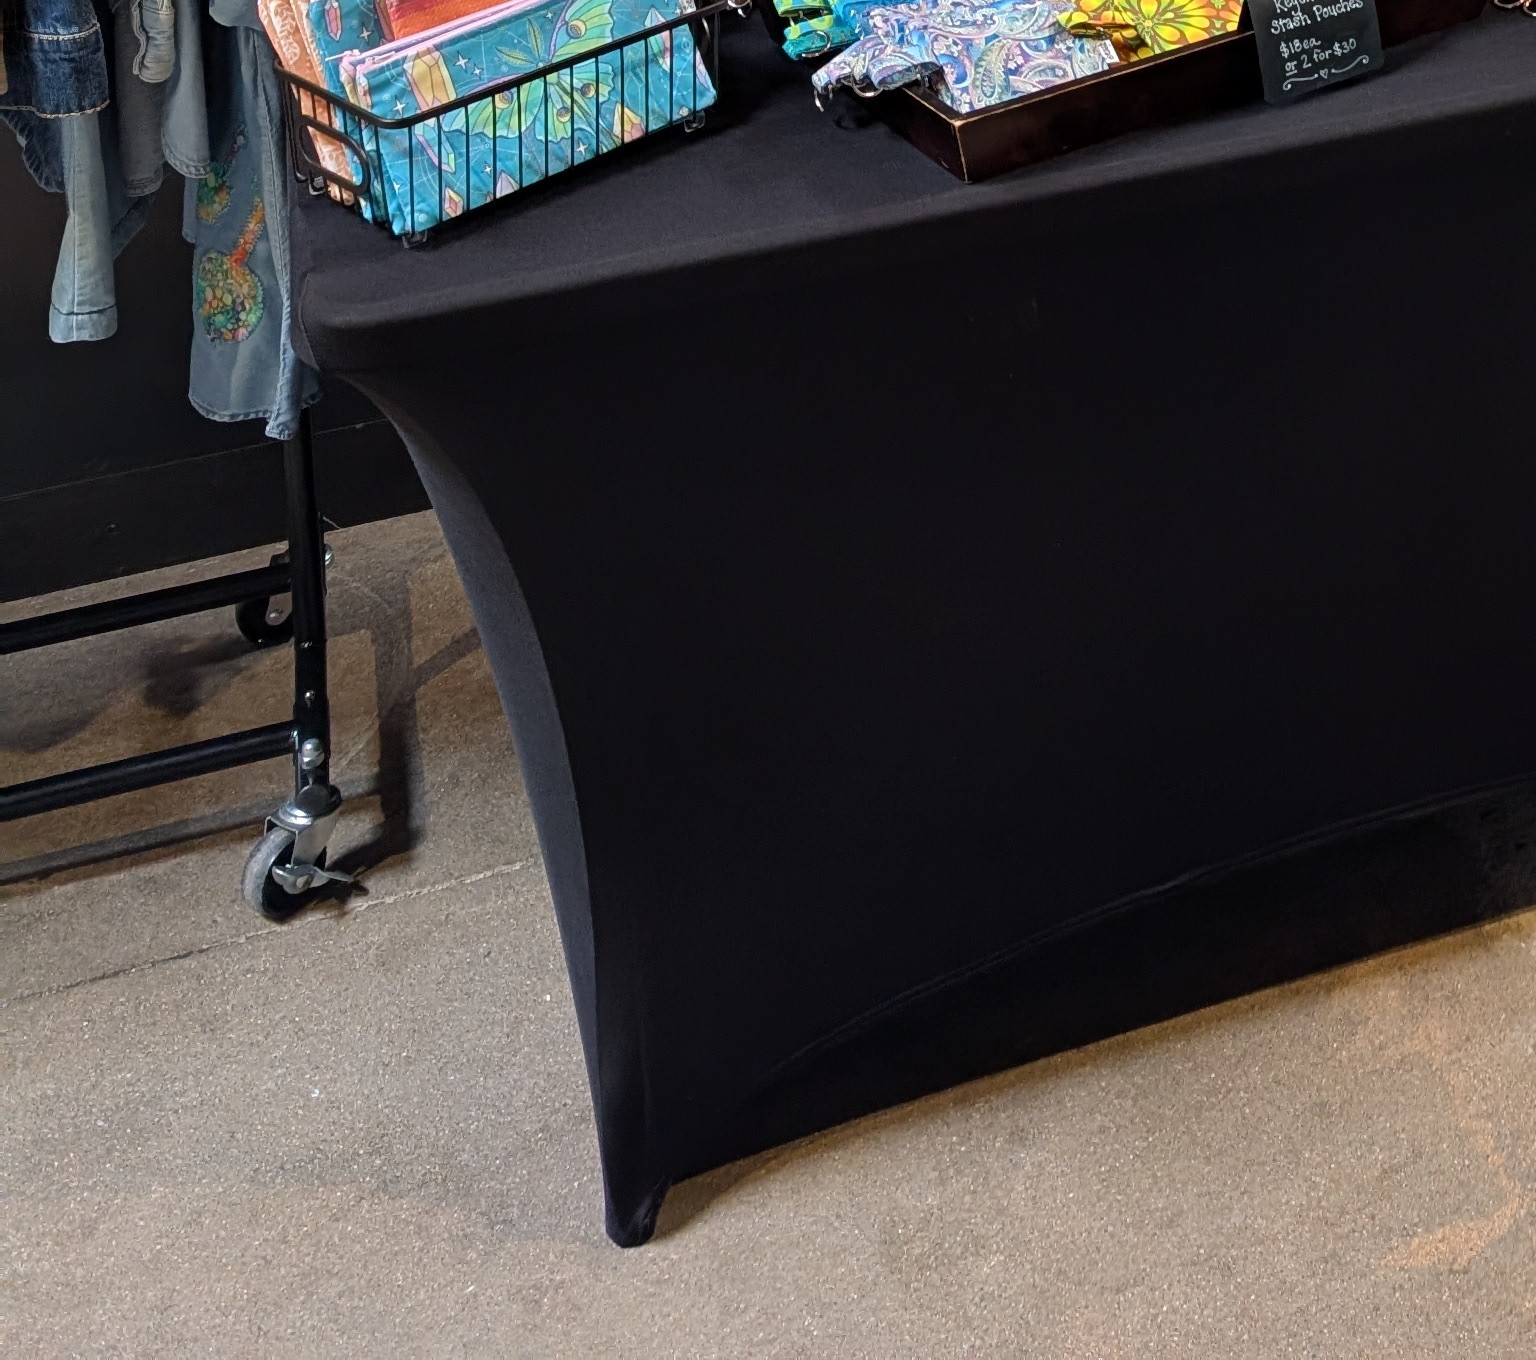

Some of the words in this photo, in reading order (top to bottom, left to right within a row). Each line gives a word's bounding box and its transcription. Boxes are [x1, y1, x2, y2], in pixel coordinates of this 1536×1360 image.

[1270, 12, 1312, 35] Stash
[1285, 60, 1298, 73] or
[1300, 54, 1312, 69] 2
[1313, 48, 1332, 63] for
[1332, 37, 1357, 57] $30
